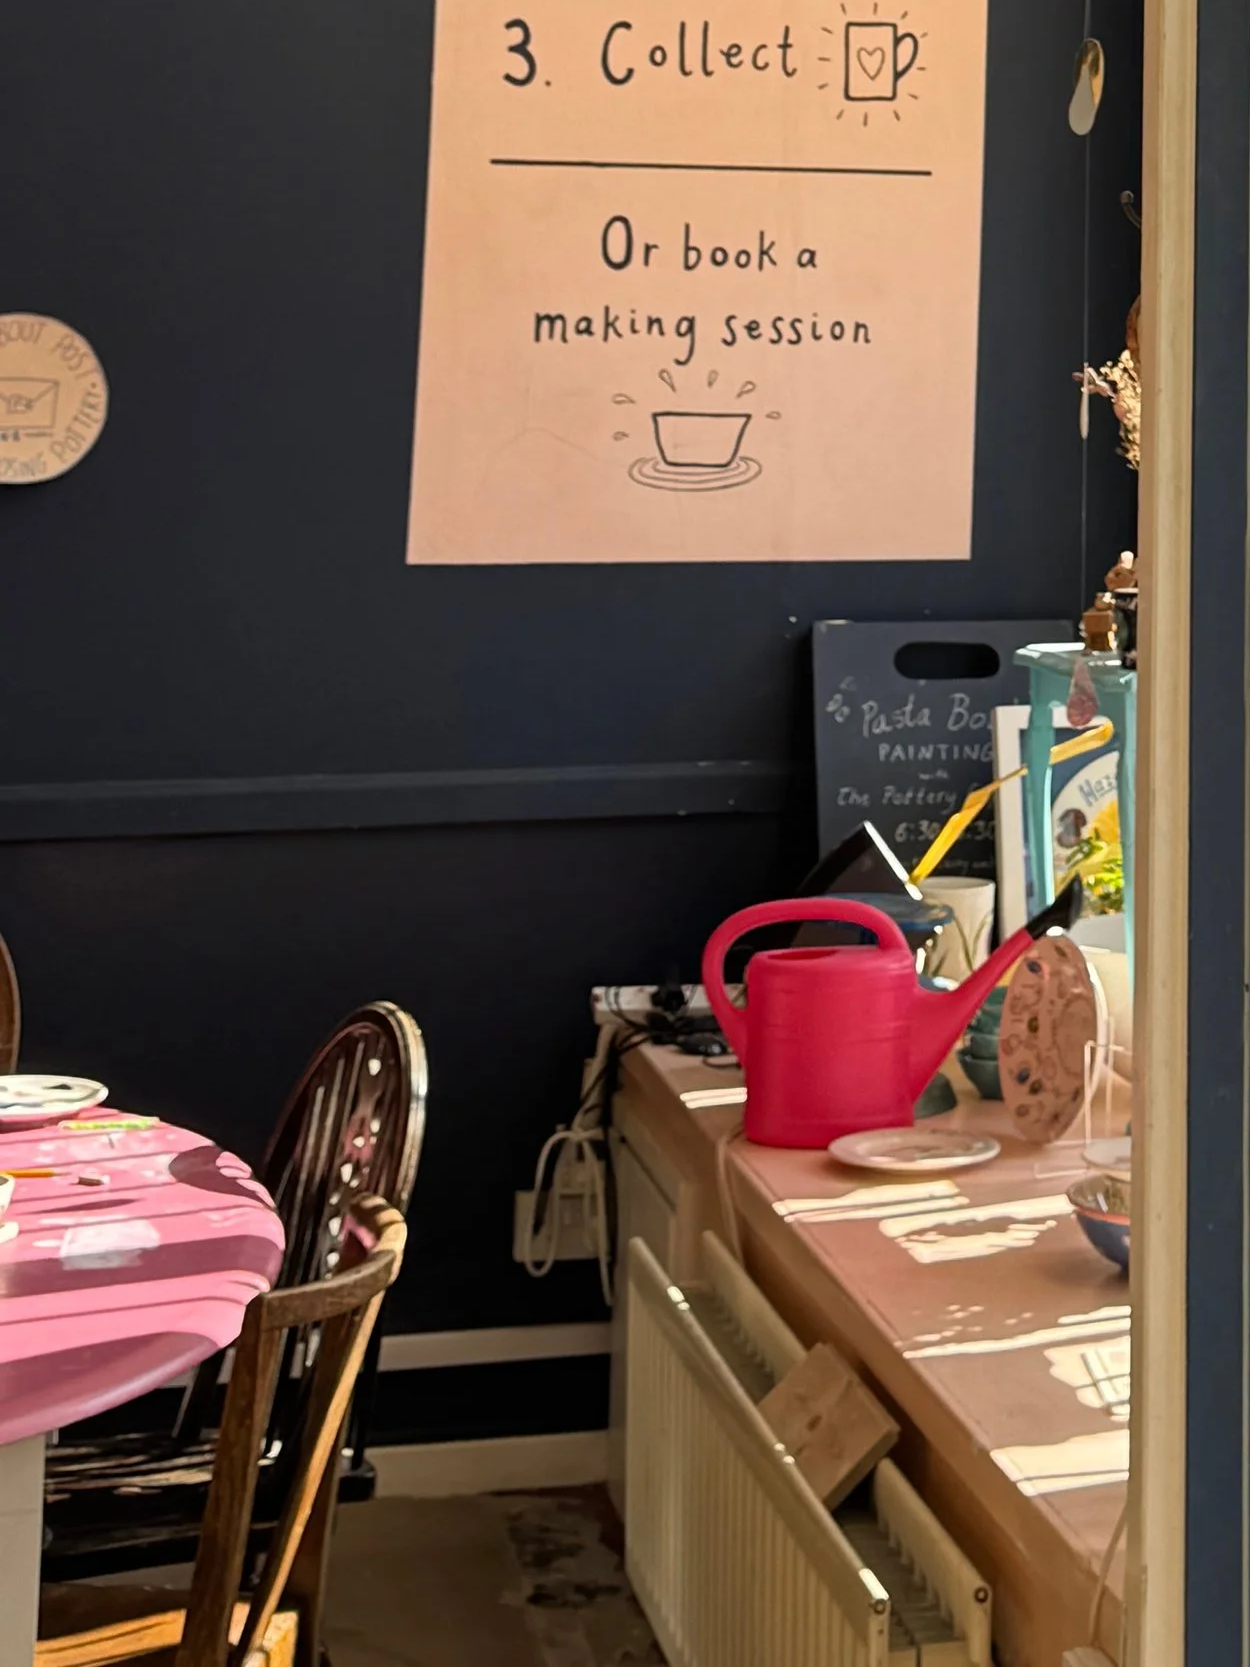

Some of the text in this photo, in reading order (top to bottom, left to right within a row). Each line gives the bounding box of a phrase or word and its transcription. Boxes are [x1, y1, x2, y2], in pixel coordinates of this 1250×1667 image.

[503, 18, 797, 87] 3. Collect
[601, 215, 818, 271] Or book a
[534, 305, 871, 366] making session
[862, 693, 993, 738] Pasta Bo
[878, 742, 994, 763] PAINTING
[881, 785, 956, 815] Pottery
